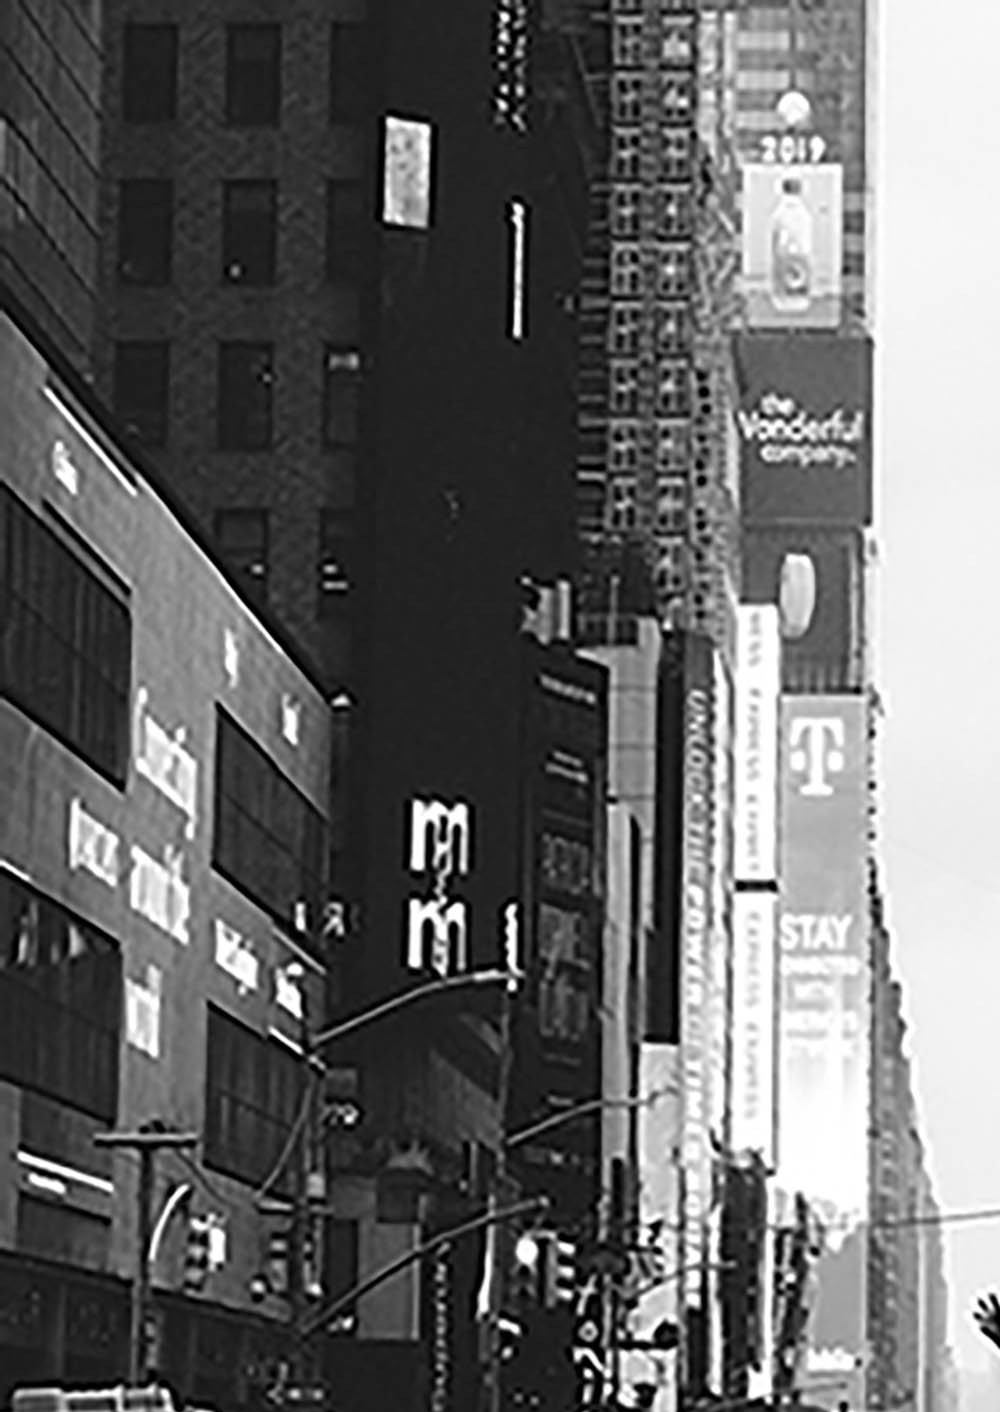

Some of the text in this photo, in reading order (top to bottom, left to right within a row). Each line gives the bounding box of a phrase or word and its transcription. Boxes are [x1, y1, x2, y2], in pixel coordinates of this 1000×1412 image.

[760, 134, 827, 162] 2019
[761, 391, 795, 416] the
[779, 914, 852, 950] STAY
